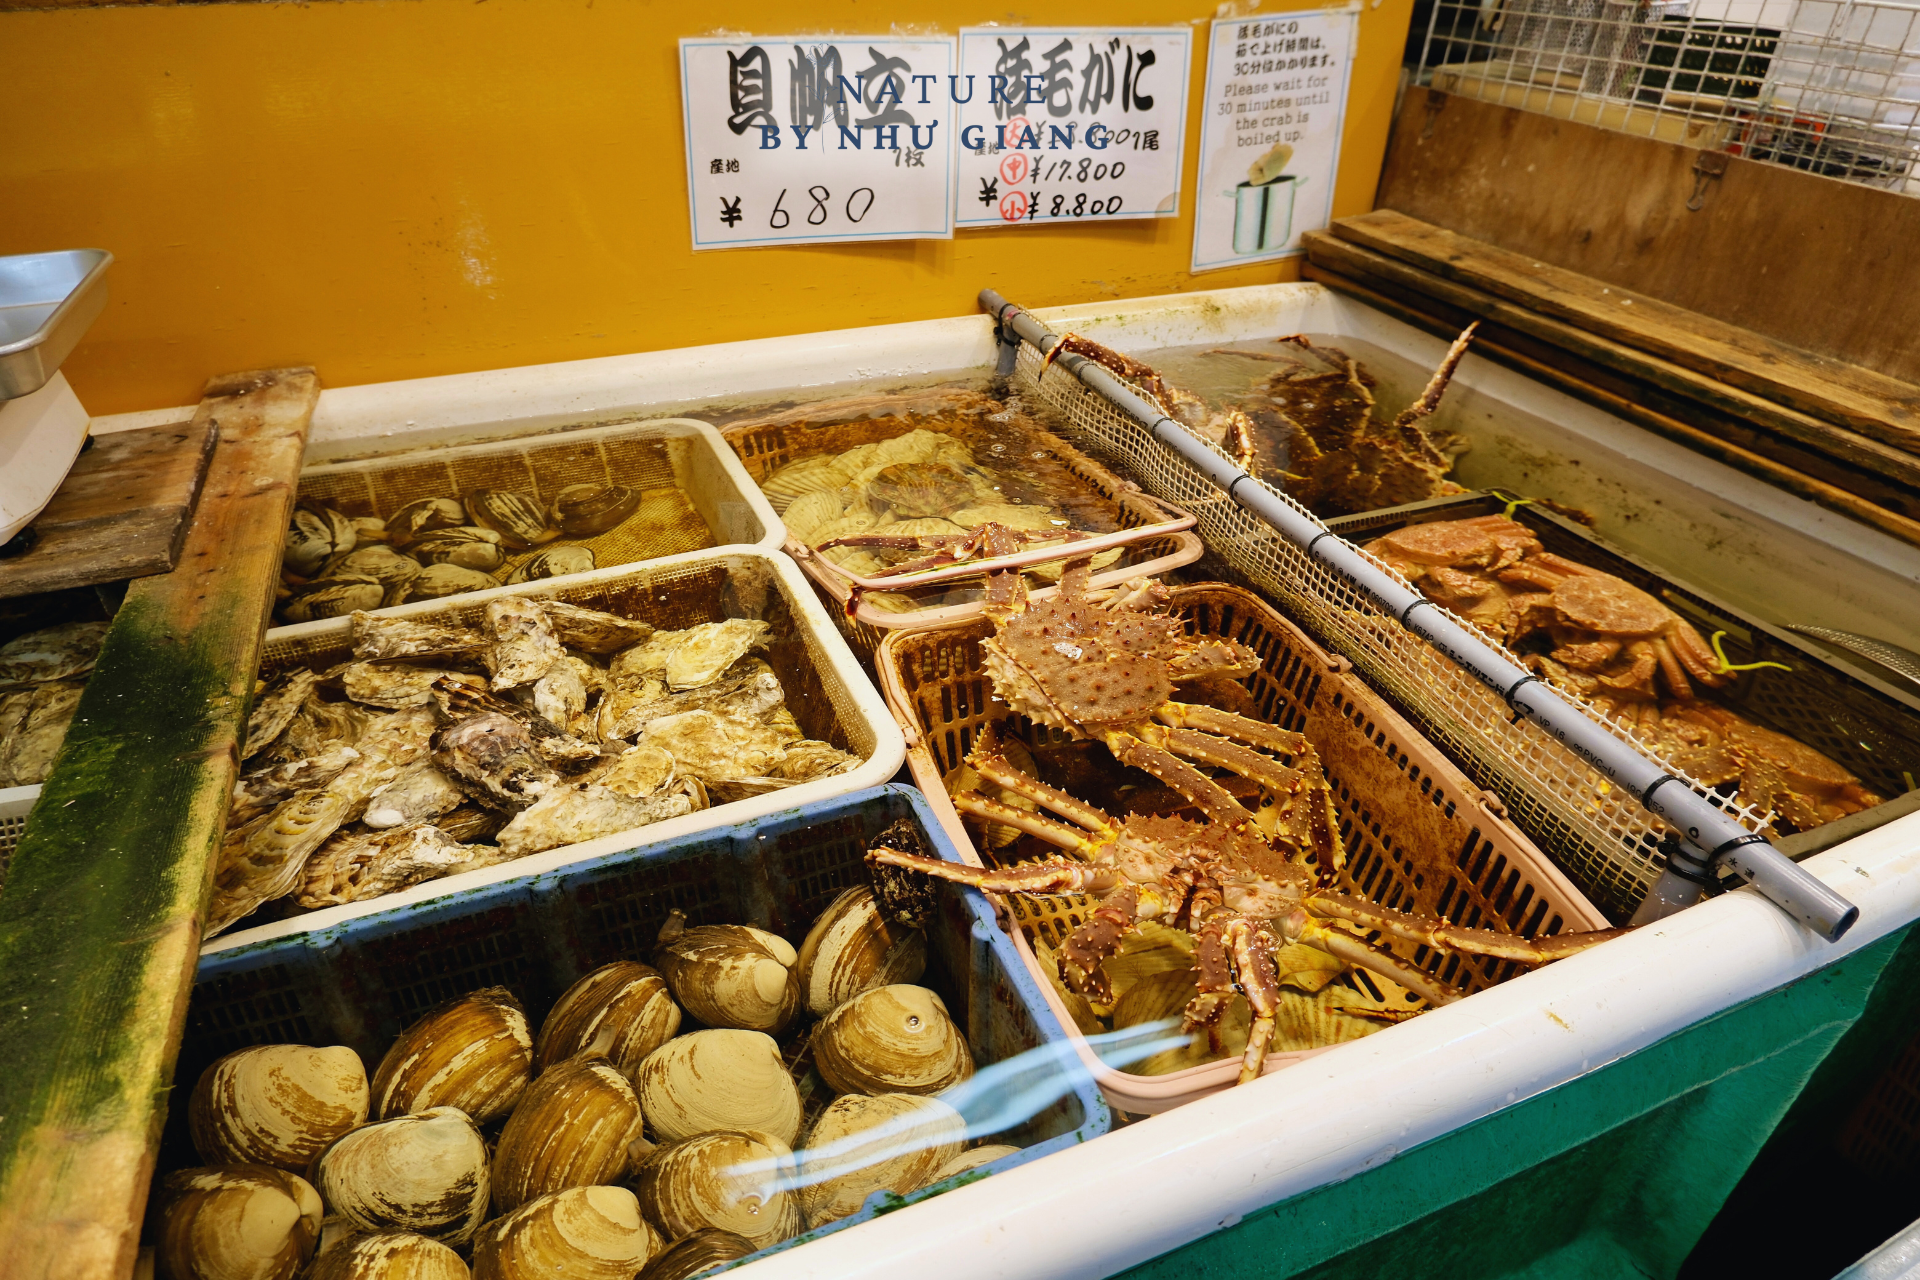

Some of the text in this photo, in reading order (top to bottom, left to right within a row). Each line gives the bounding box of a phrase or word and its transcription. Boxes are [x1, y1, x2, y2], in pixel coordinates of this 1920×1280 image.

[1224, 74, 1329, 98] Please wait for
[1217, 91, 1330, 117] 30 minutes until
[1235, 110, 1310, 131] the crab is
[1237, 130, 1305, 148] boiled up.
[710, 157, 741, 175] 産地
